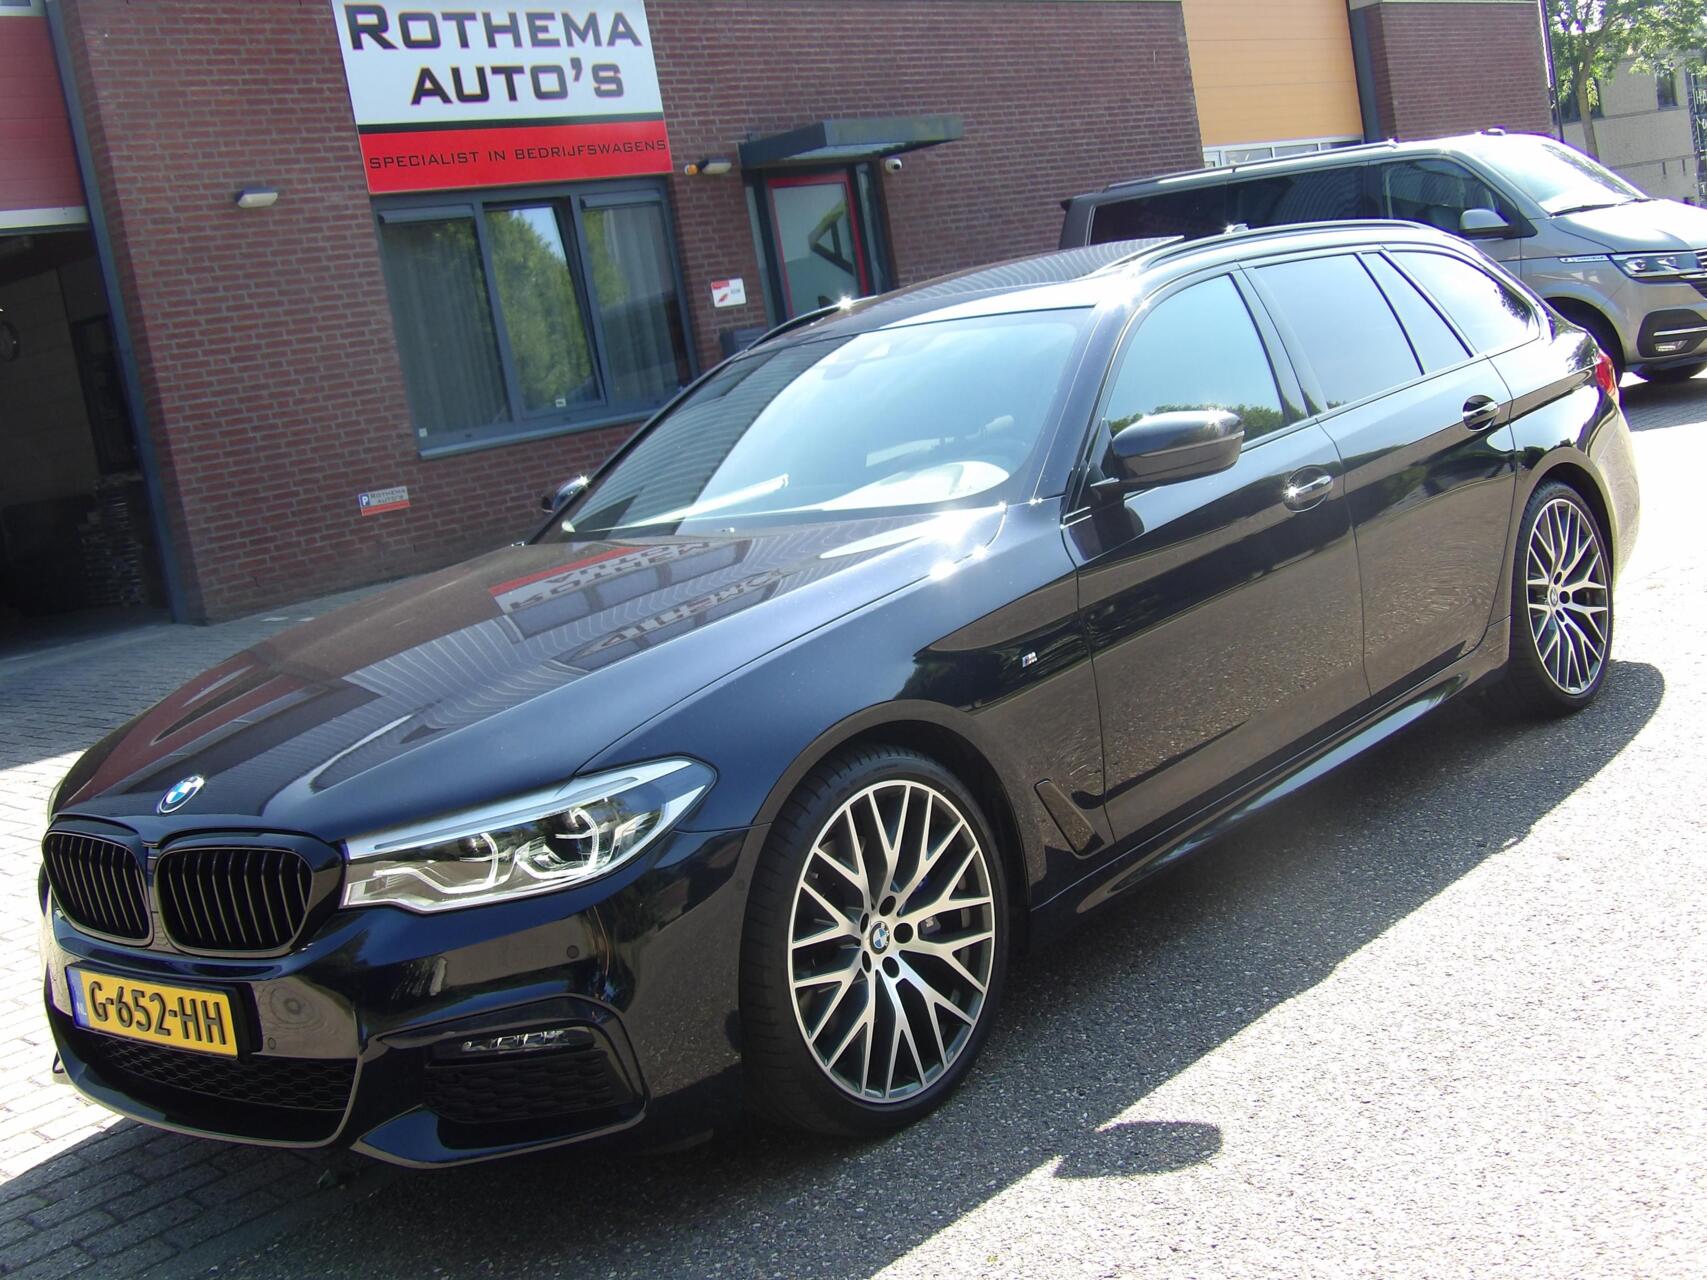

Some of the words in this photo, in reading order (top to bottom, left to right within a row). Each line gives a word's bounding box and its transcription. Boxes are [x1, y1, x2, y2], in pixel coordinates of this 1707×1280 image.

[344, 4, 642, 50] ROTHEMA
[410, 57, 624, 104] AUTO'S
[369, 150, 479, 169] SPECIALIST
[488, 149, 506, 162] IN
[514, 139, 666, 161] BEDRIJFSWAGENS
[89, 981, 227, 1045] G-652-HH
